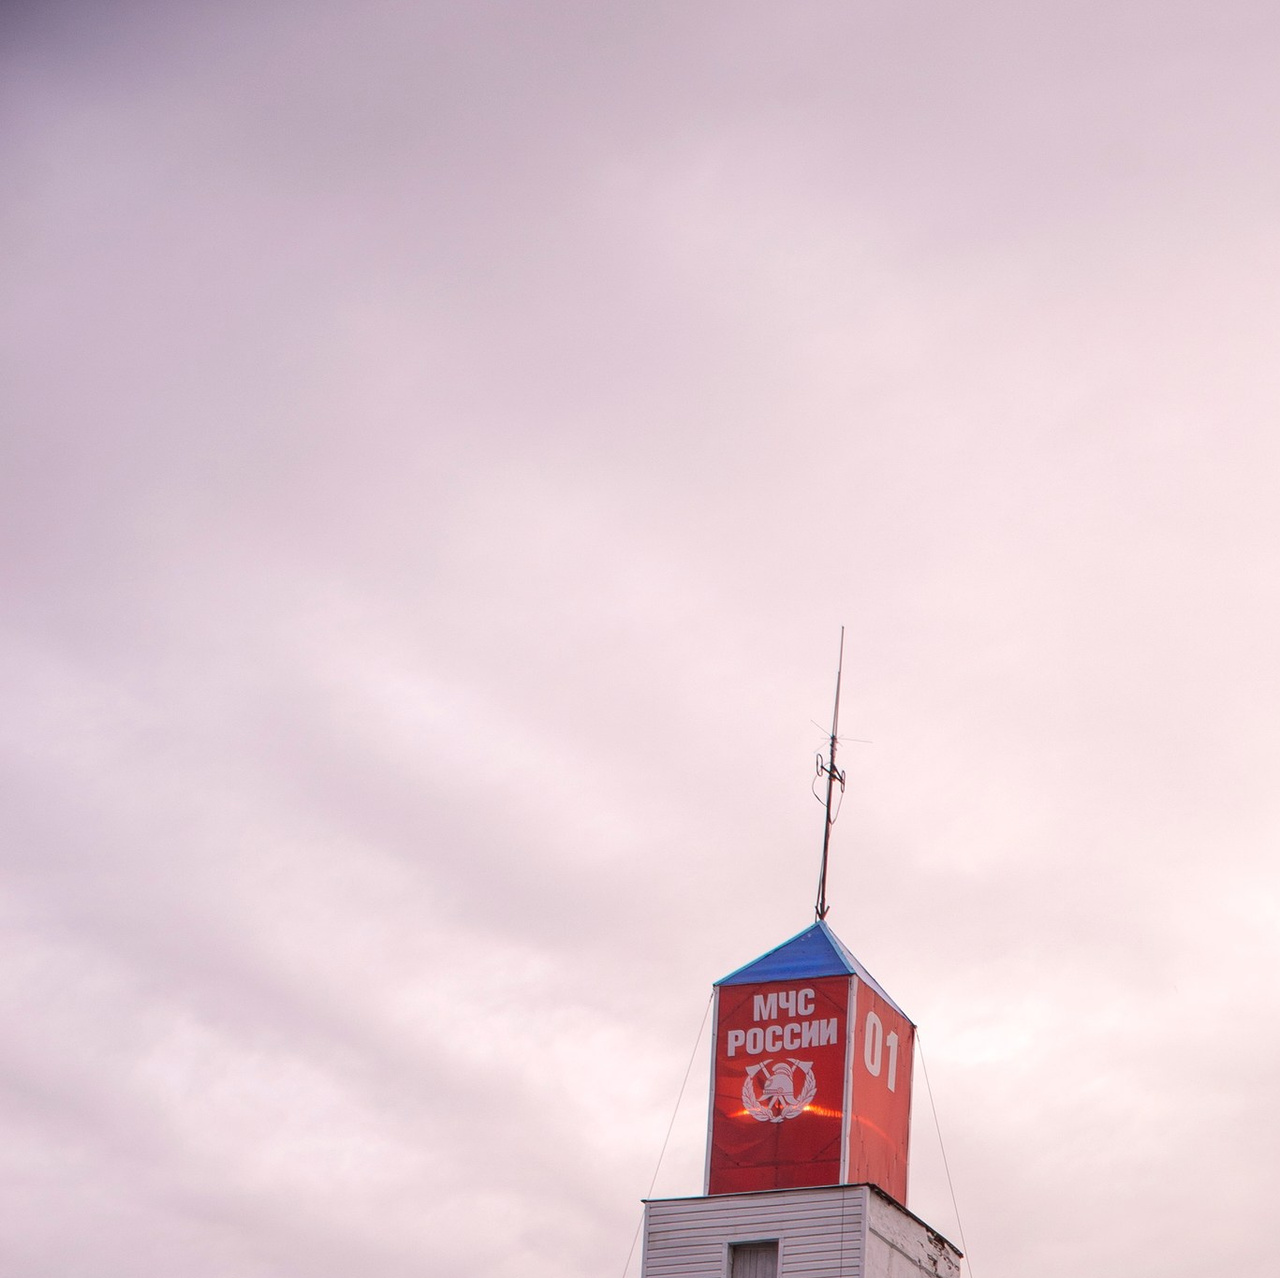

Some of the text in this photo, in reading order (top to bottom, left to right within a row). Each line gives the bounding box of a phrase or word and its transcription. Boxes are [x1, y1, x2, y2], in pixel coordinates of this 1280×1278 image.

[753, 988, 816, 1022] МЧС
[727, 1018, 838, 1057] РОССИИ
[864, 1011, 899, 1094] 01
